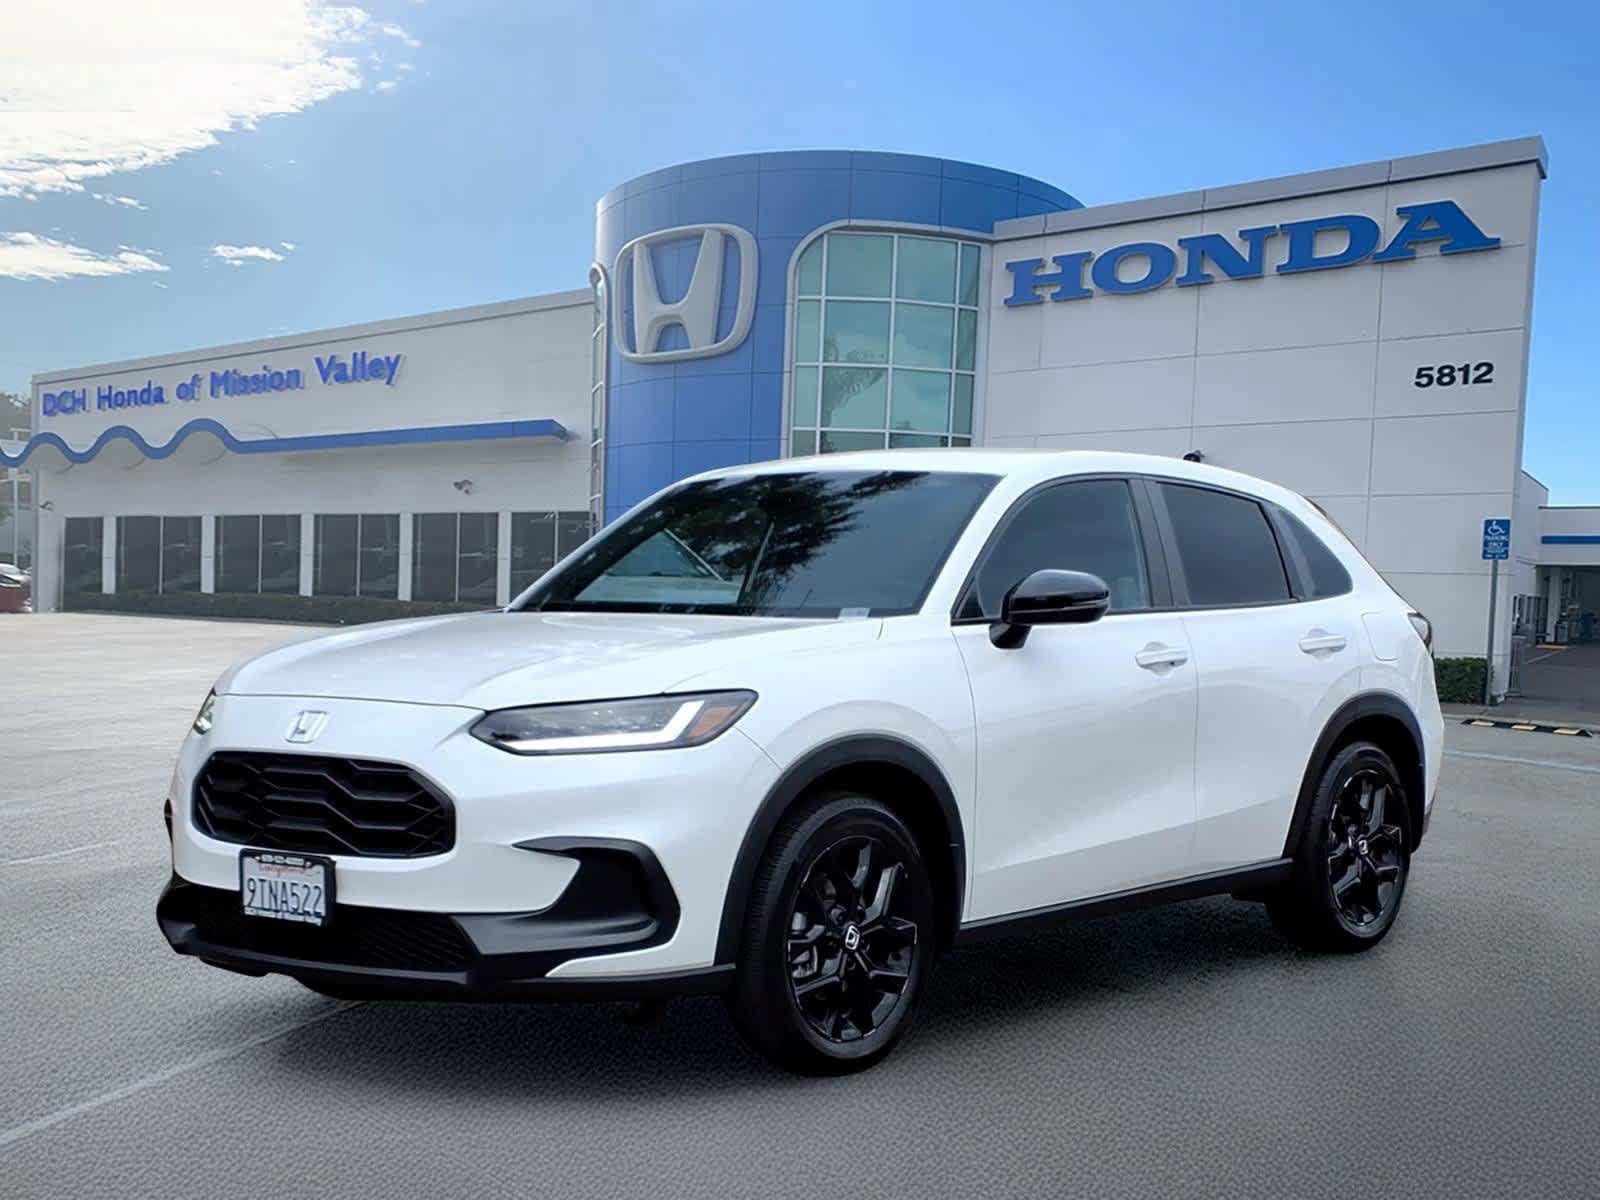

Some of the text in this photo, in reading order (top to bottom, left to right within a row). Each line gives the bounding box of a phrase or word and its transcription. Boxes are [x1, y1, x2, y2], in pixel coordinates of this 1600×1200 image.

[1004, 199, 1501, 307] HONDA
[42, 351, 401, 417] DCH Honda of Mission Valley
[1413, 361, 1495, 389] 5812
[247, 877, 323, 918] 9TNA522
